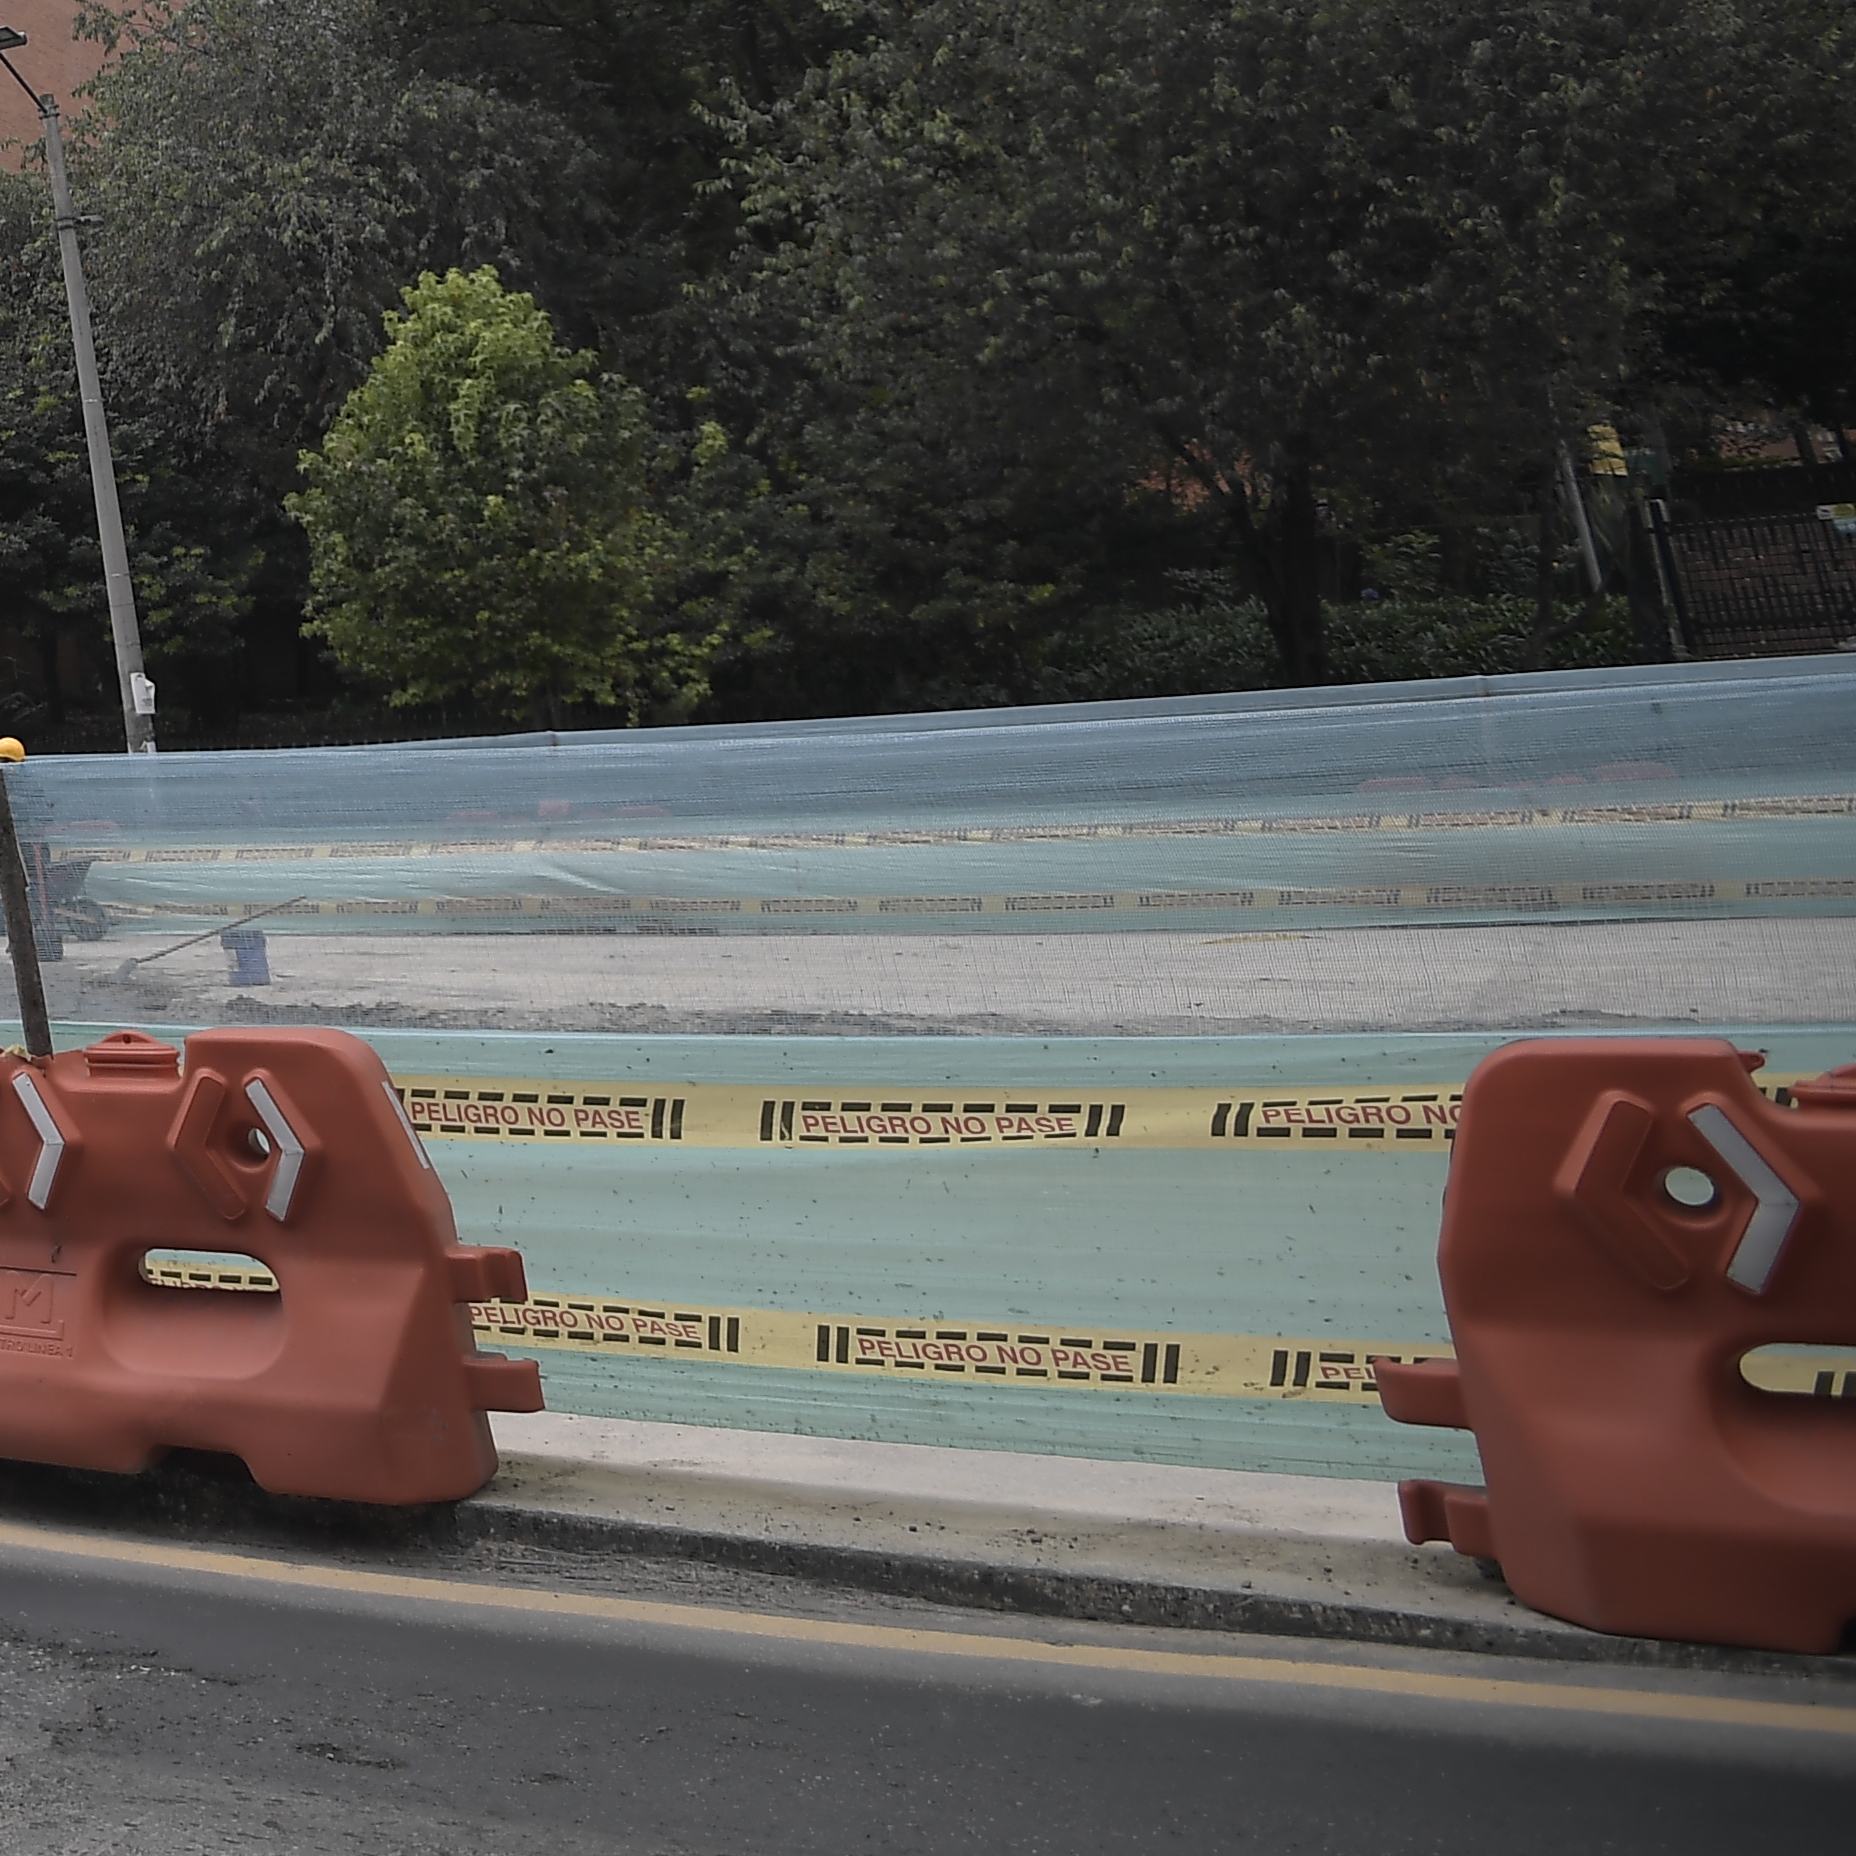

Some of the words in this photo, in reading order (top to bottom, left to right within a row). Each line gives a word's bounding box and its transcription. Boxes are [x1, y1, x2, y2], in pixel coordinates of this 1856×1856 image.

[412, 1102, 519, 1125] PELIGRO
[528, 1108, 566, 1127] NO
[574, 1109, 643, 1129] PASE
[802, 1114, 932, 1135] PELIGRO
[942, 1117, 986, 1135] NO
[995, 1117, 1077, 1134] PASE
[1261, 1105, 1412, 1125] PELIGRO
[471, 1306, 578, 1328] PELIGRO
[587, 1314, 625, 1333] NO
[633, 1319, 701, 1339] PASE
[858, 1338, 987, 1363] PELIGRO
[997, 1344, 1042, 1366] NO
[1051, 1349, 1133, 1373] PASE
